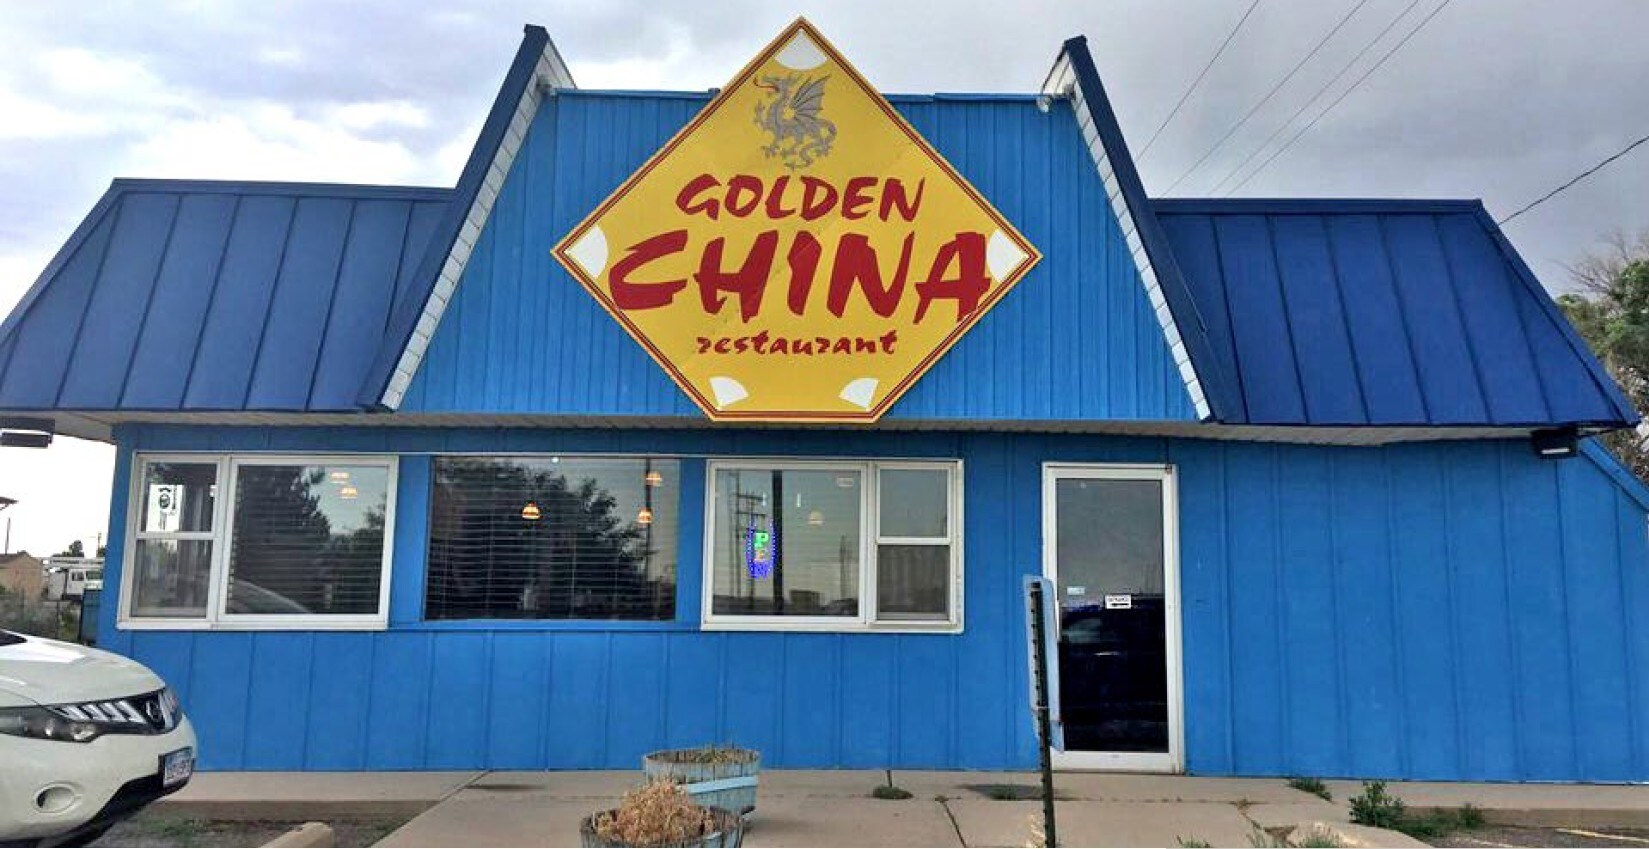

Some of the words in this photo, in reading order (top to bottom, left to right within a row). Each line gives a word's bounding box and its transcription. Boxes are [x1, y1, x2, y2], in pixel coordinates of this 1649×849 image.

[675, 174, 925, 222] GOLDEN
[608, 229, 991, 324] CHINA
[697, 331, 898, 356] restaurant
